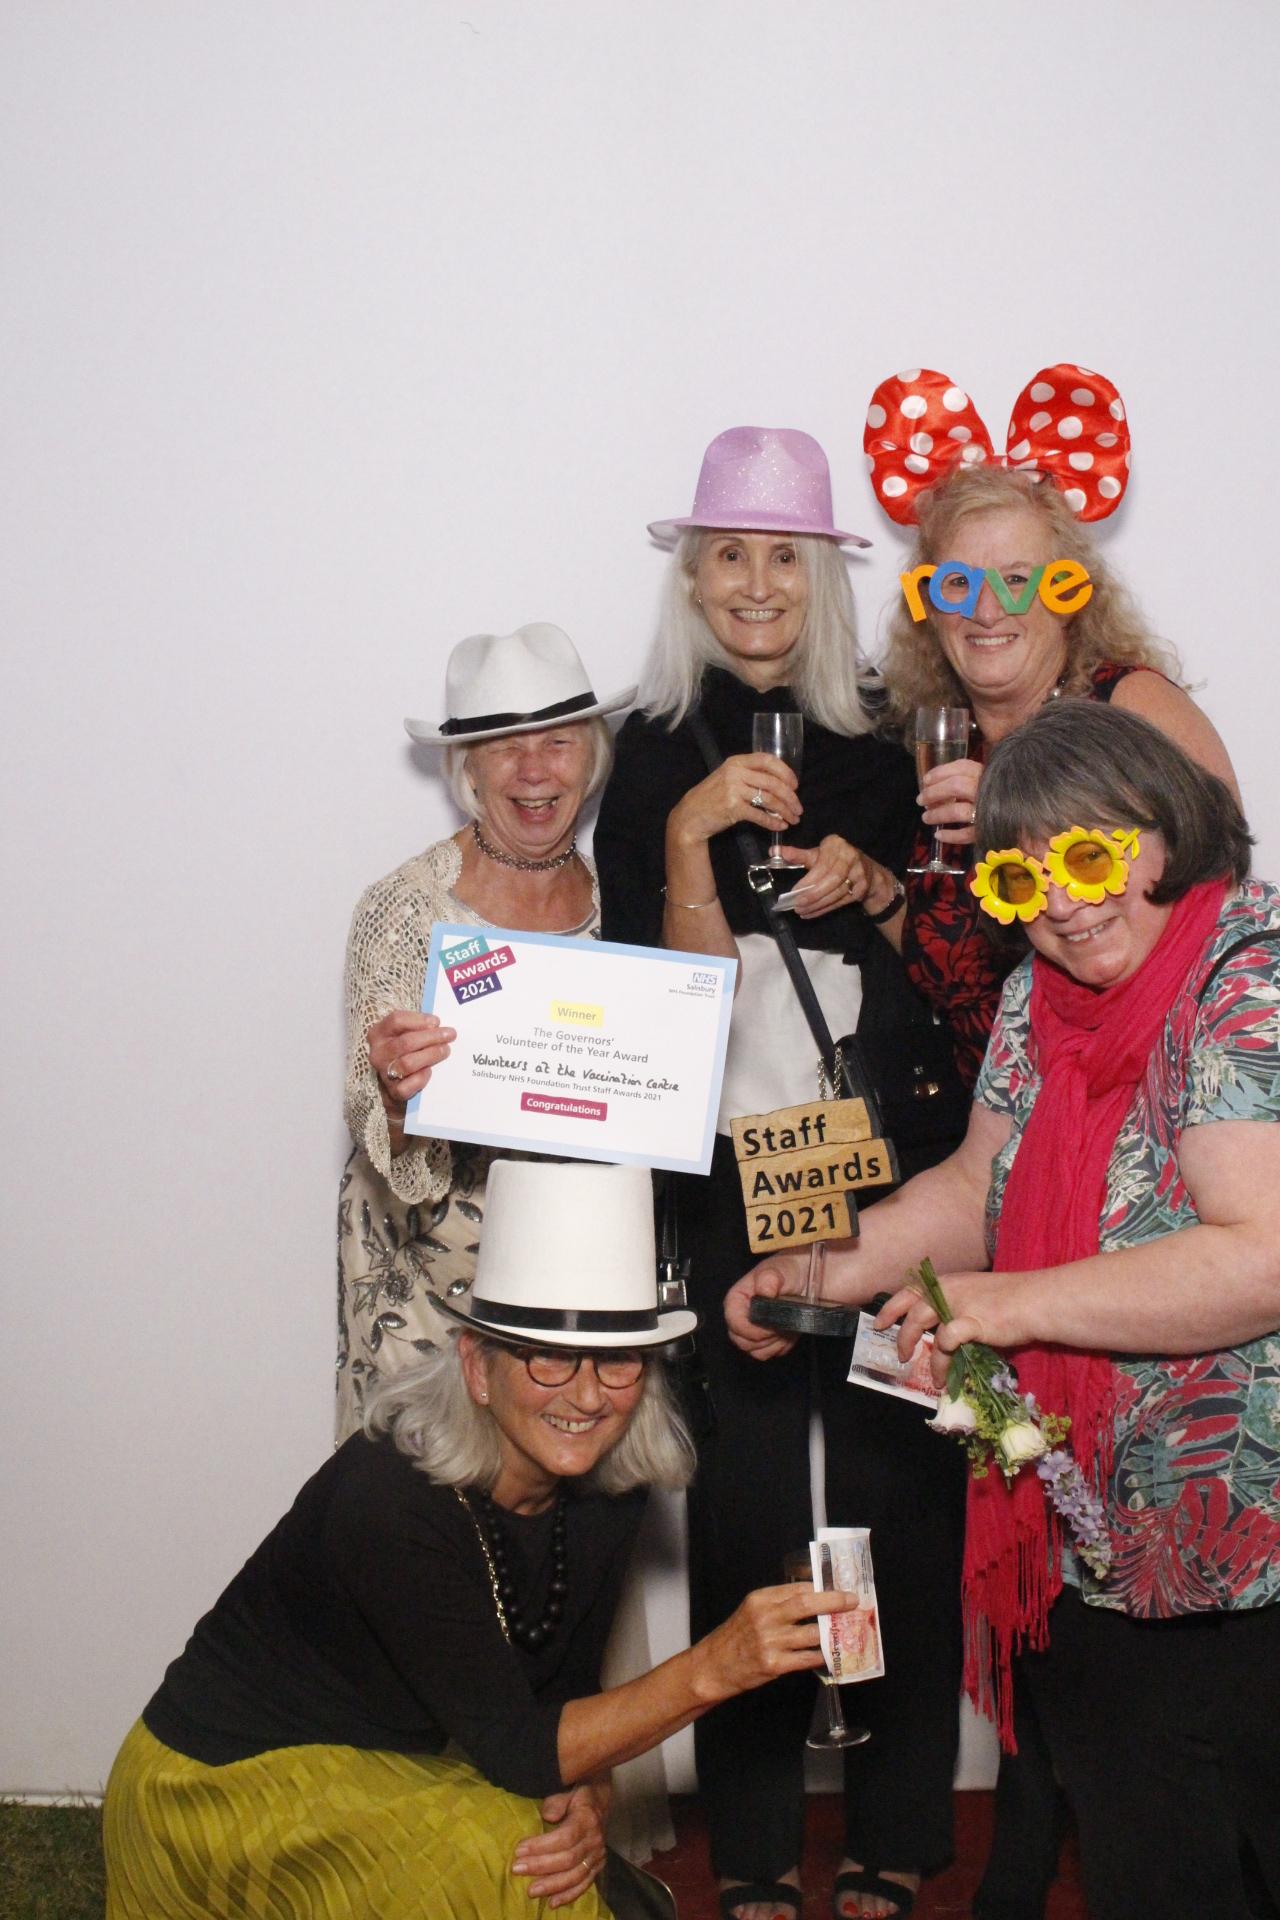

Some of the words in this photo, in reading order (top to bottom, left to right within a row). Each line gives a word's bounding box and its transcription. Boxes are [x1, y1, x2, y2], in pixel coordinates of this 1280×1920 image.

[899, 559, 1093, 623] rave
[445, 940, 481, 965] Staff
[453, 952, 509, 983] Awards
[459, 976, 496, 1000] 2021
[693, 973, 717, 984] NHS
[557, 1007, 596, 1021] Winner
[533, 1027, 553, 1039] The
[496, 1034, 548, 1049] Volunteer
[551, 1042, 563, 1051] of
[566, 1044, 583, 1055] the
[587, 1046, 610, 1058] Year
[613, 1050, 648, 1063] Award
[472, 1069, 506, 1082] Salisbury
[508, 1074, 525, 1083] NHS
[527, 1077, 570, 1089] Foundation
[573, 1083, 591, 1092] Trust
[593, 1085, 611, 1095] Staff
[613, 1088, 642, 1099] Awards
[643, 1092, 662, 1101] 2021
[473, 1053, 528, 1071] Volunteers
[535, 1061, 550, 1074] at
[557, 1063, 576, 1078] the
[583, 1068, 642, 1086] Vaccination
[646, 1078, 679, 1091] Centre
[526, 1098, 601, 1116] Congratulations
[742, 1113, 827, 1156] Staff
[751, 1152, 881, 1199] Awards
[755, 1203, 836, 1242] 2021
